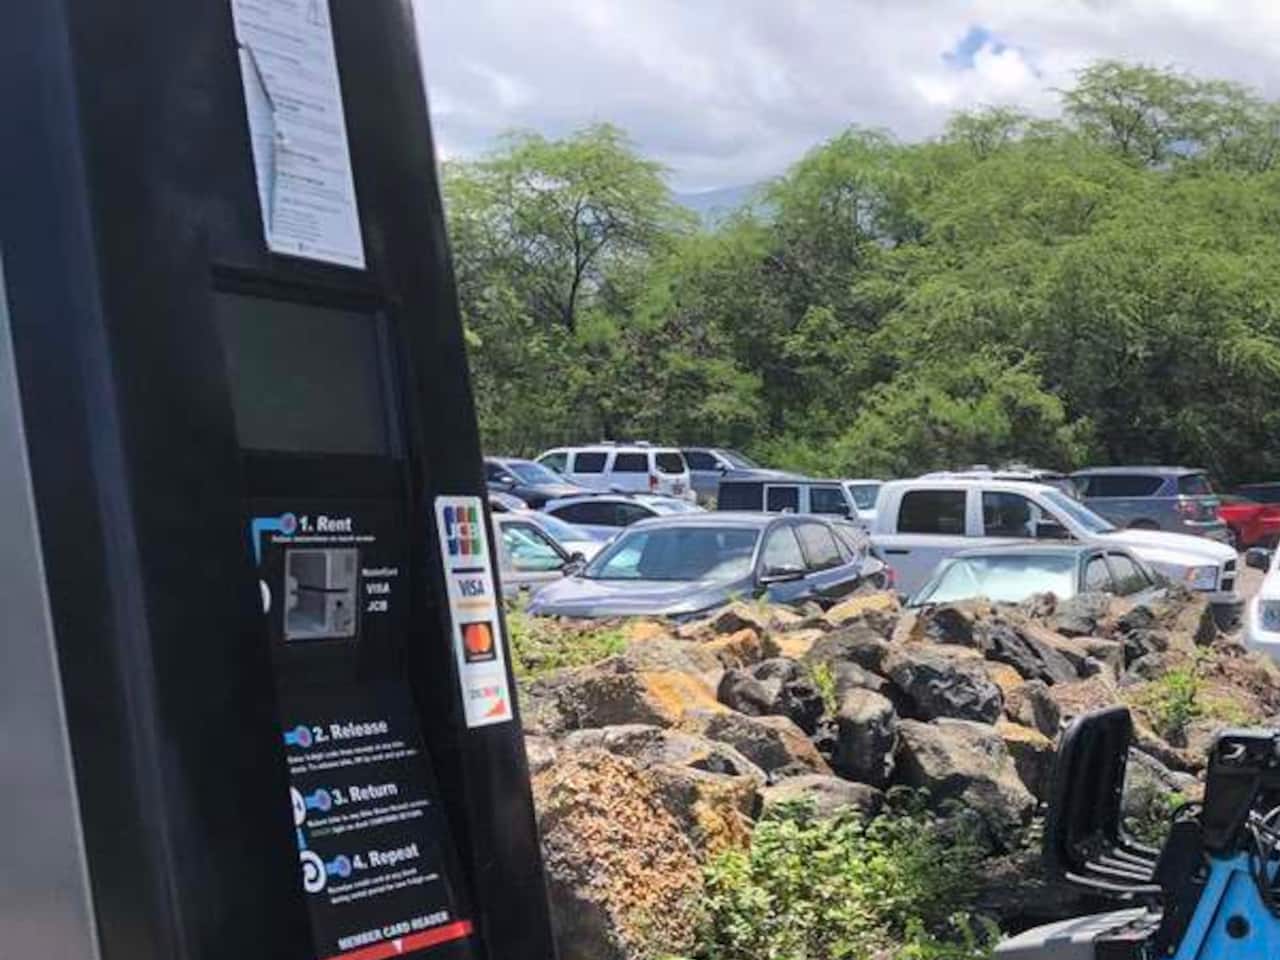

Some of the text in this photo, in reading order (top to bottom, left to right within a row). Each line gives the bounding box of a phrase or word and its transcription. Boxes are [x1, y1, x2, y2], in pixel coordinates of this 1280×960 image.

[299, 516, 353, 532] 1. Rent
[366, 582, 390, 595] VISA
[458, 579, 485, 597] VISA
[312, 720, 388, 743] 2. Release
[331, 783, 398, 806] 3. Return
[353, 842, 420, 869] 4. Repeat
[338, 910, 449, 951] MEMBER CARD READER
